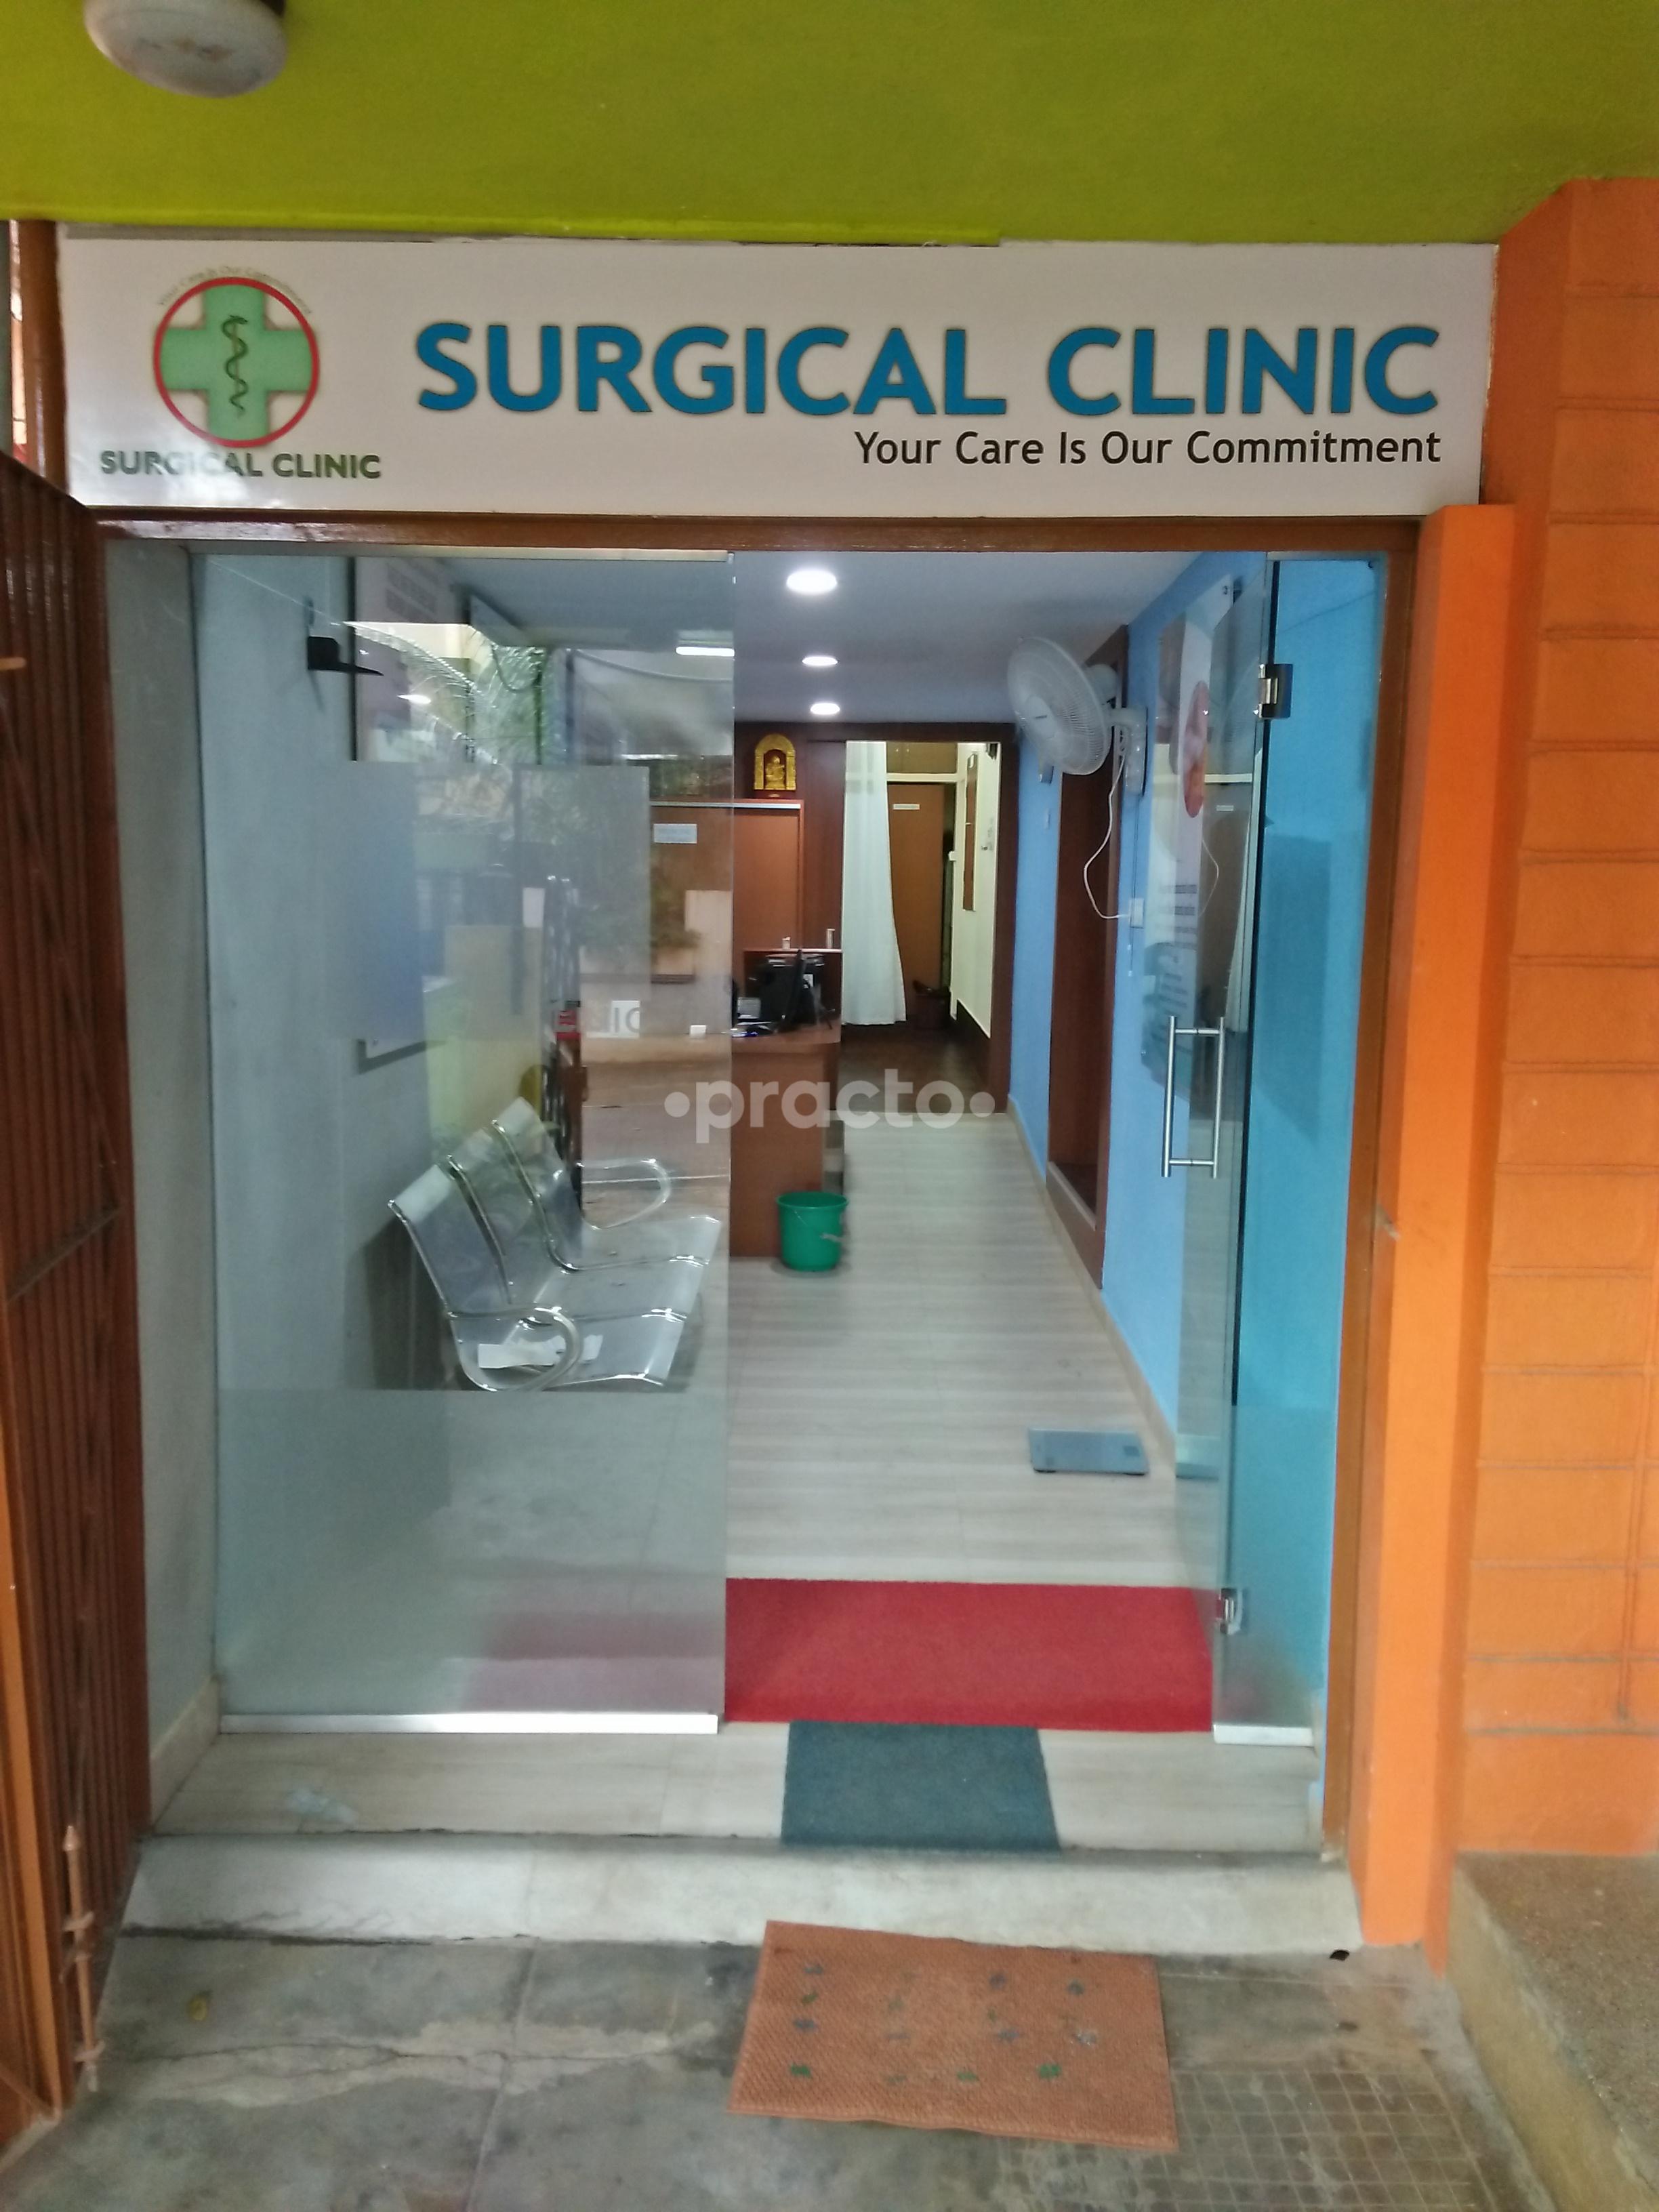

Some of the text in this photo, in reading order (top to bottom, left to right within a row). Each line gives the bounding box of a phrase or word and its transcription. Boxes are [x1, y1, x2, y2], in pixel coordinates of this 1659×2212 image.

[417, 325, 1436, 415] SURGICAL CLINIC
[855, 430, 1441, 464] Your Care Is Our Commitment
[101, 451, 381, 479] SURGICAL CLINIC
